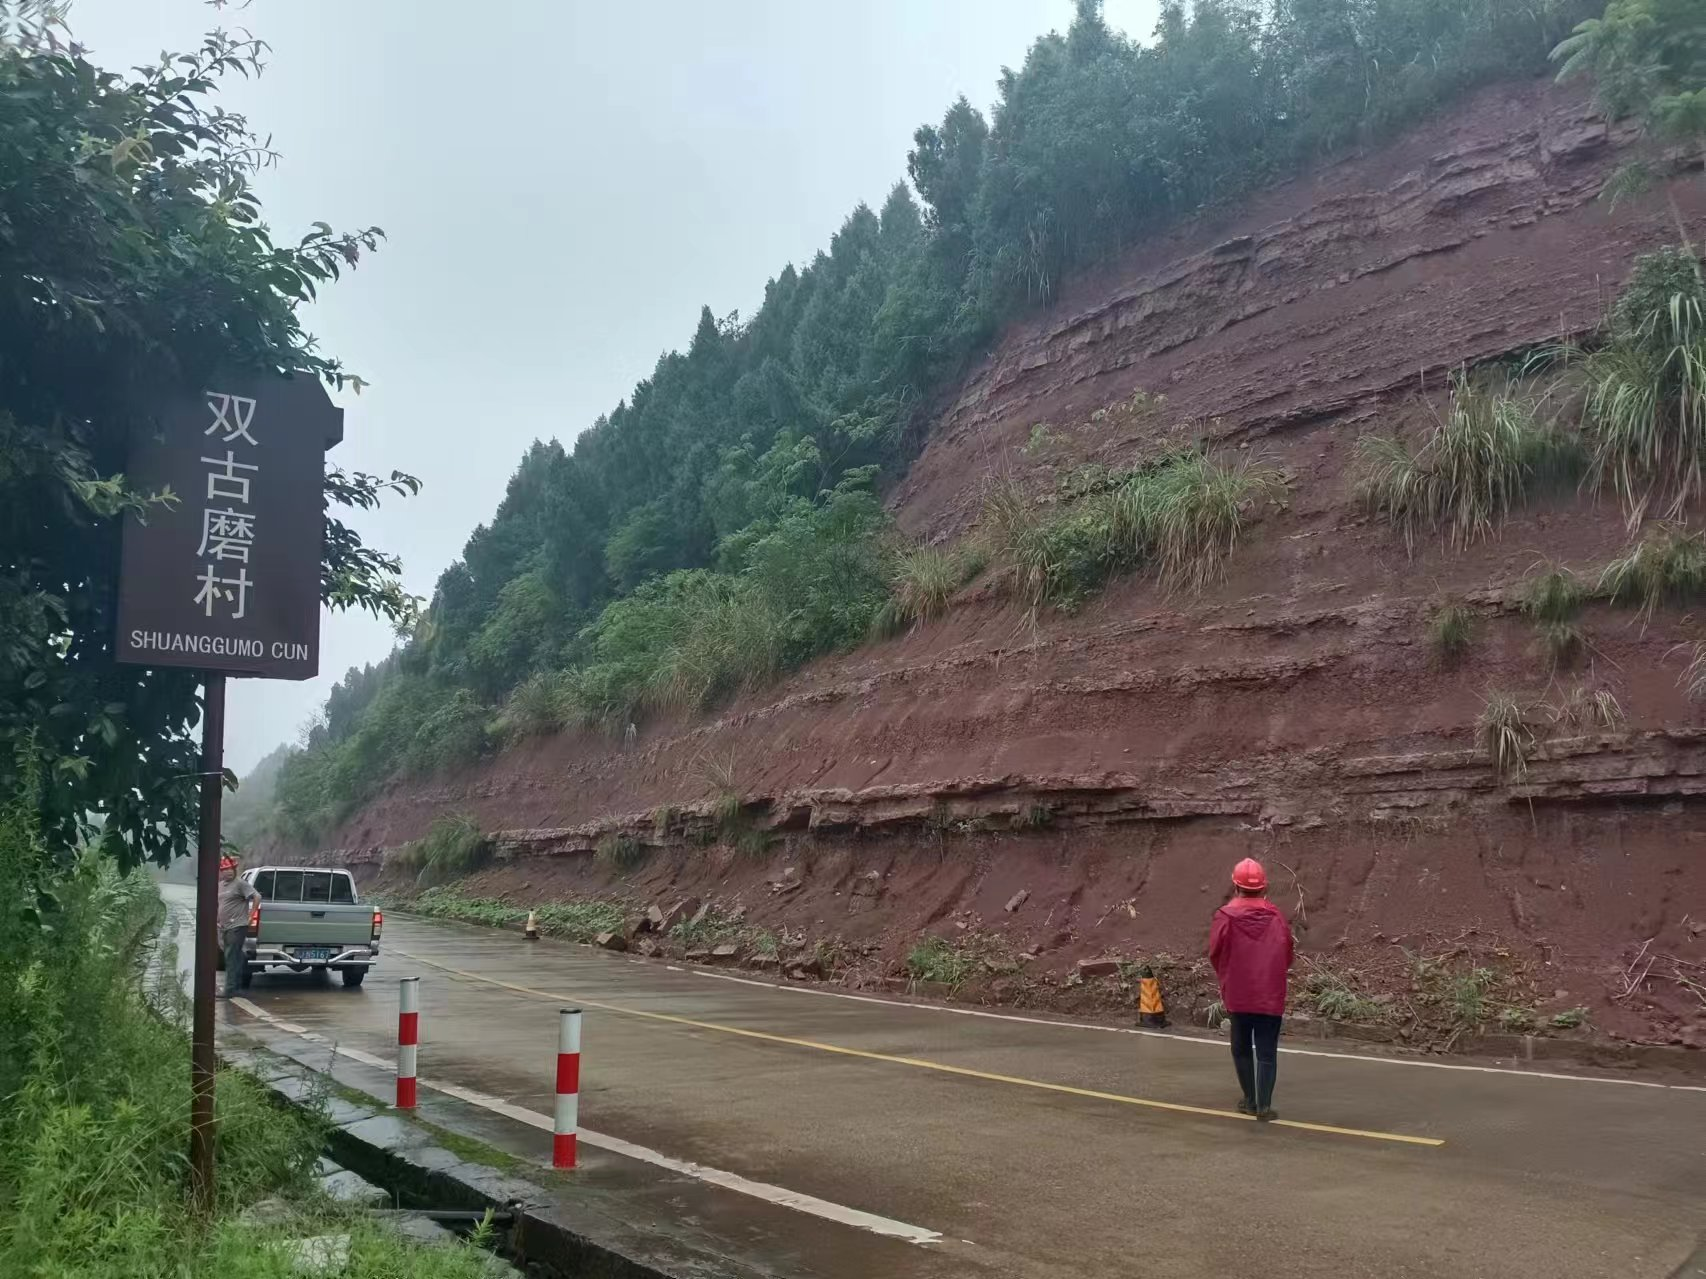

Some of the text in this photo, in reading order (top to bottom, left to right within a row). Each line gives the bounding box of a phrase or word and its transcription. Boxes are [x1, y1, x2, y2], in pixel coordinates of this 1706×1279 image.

[193, 391, 259, 619] 双古磨村
[130, 630, 308, 660] SHUANGGUMO CUN
